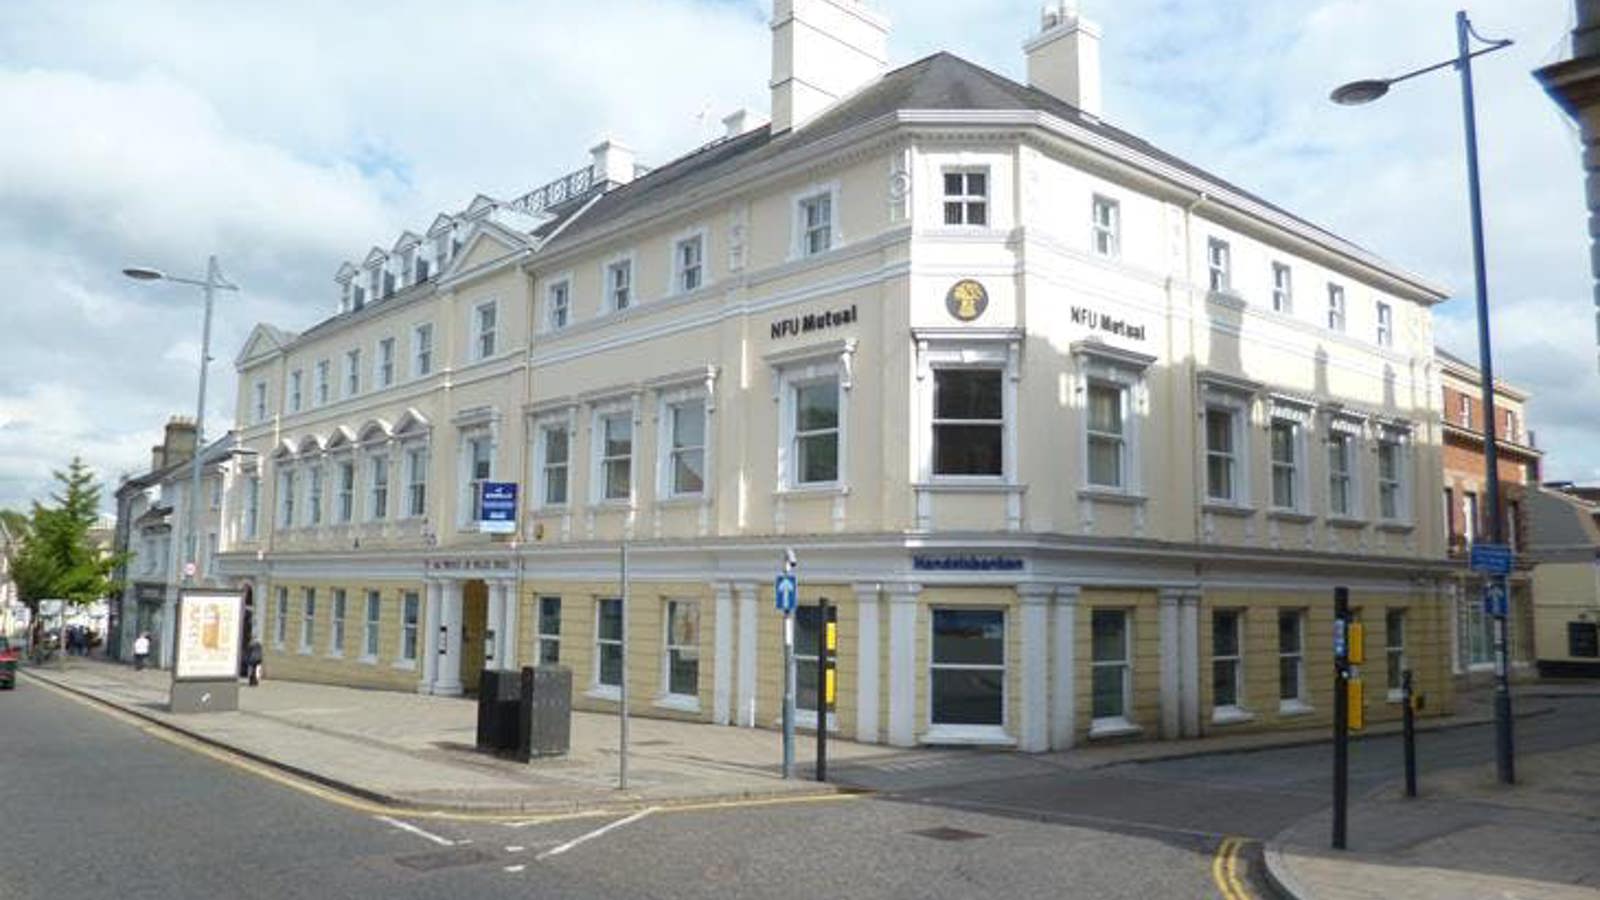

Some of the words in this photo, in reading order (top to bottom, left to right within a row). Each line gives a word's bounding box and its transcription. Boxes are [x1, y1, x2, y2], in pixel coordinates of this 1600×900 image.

[771, 316, 799, 339] NFU
[802, 304, 858, 333] Mutual
[1070, 306, 1097, 329] NFU
[1100, 313, 1145, 341] Mutual
[913, 555, 1024, 571] Handelsbanken
